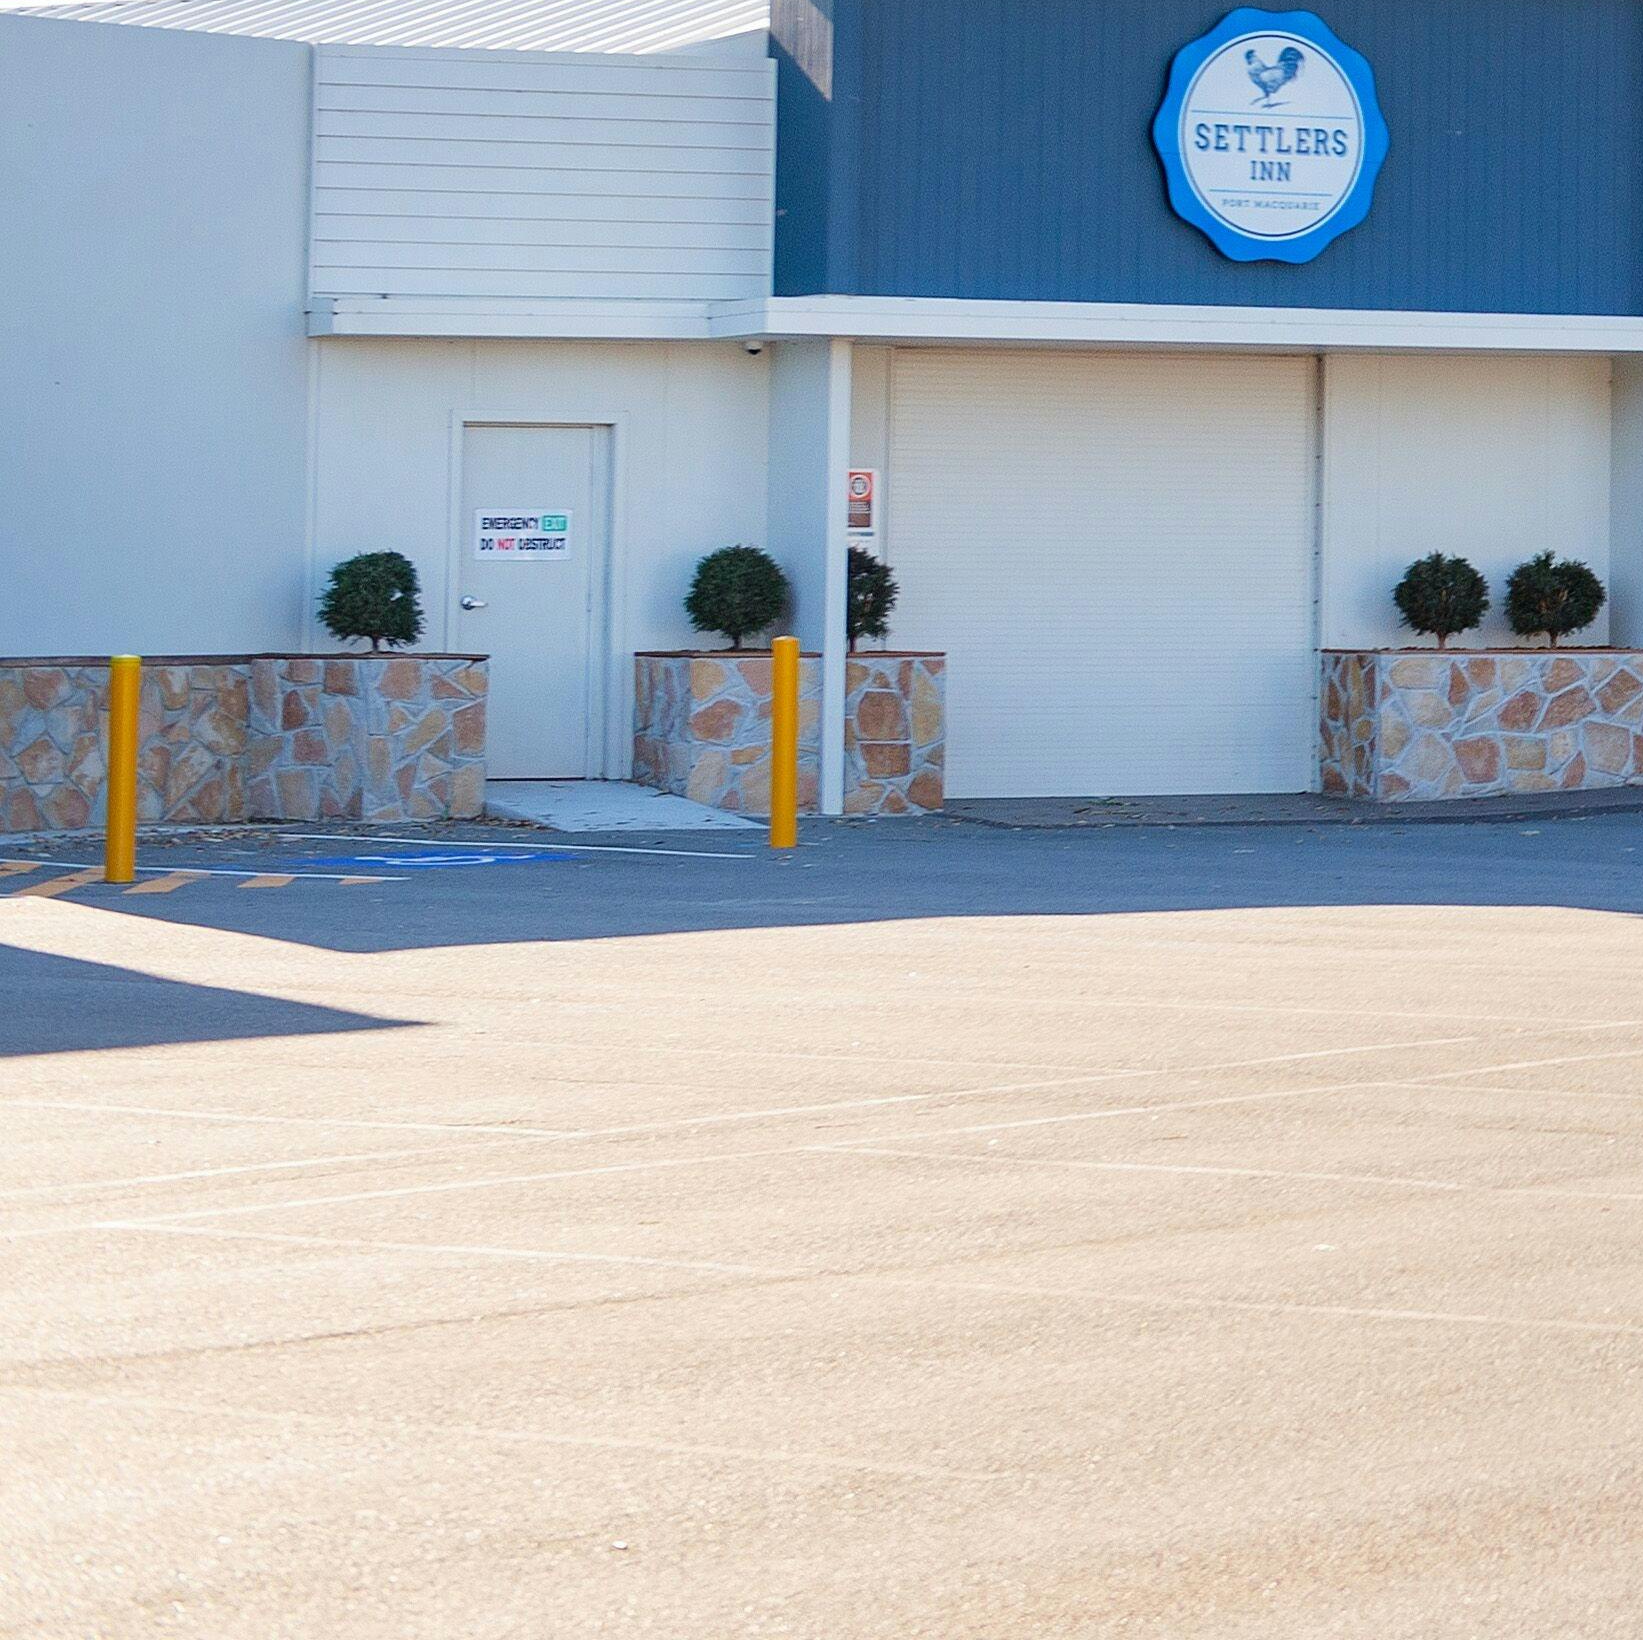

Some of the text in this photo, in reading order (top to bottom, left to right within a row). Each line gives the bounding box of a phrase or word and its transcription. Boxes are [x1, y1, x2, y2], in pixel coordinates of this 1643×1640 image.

[1194, 123, 1348, 156] SETTLERS
[1250, 160, 1291, 181] INN
[482, 517, 539, 530] EMERGENCY
[481, 537, 565, 550] DO NOT OBSTRUCT
